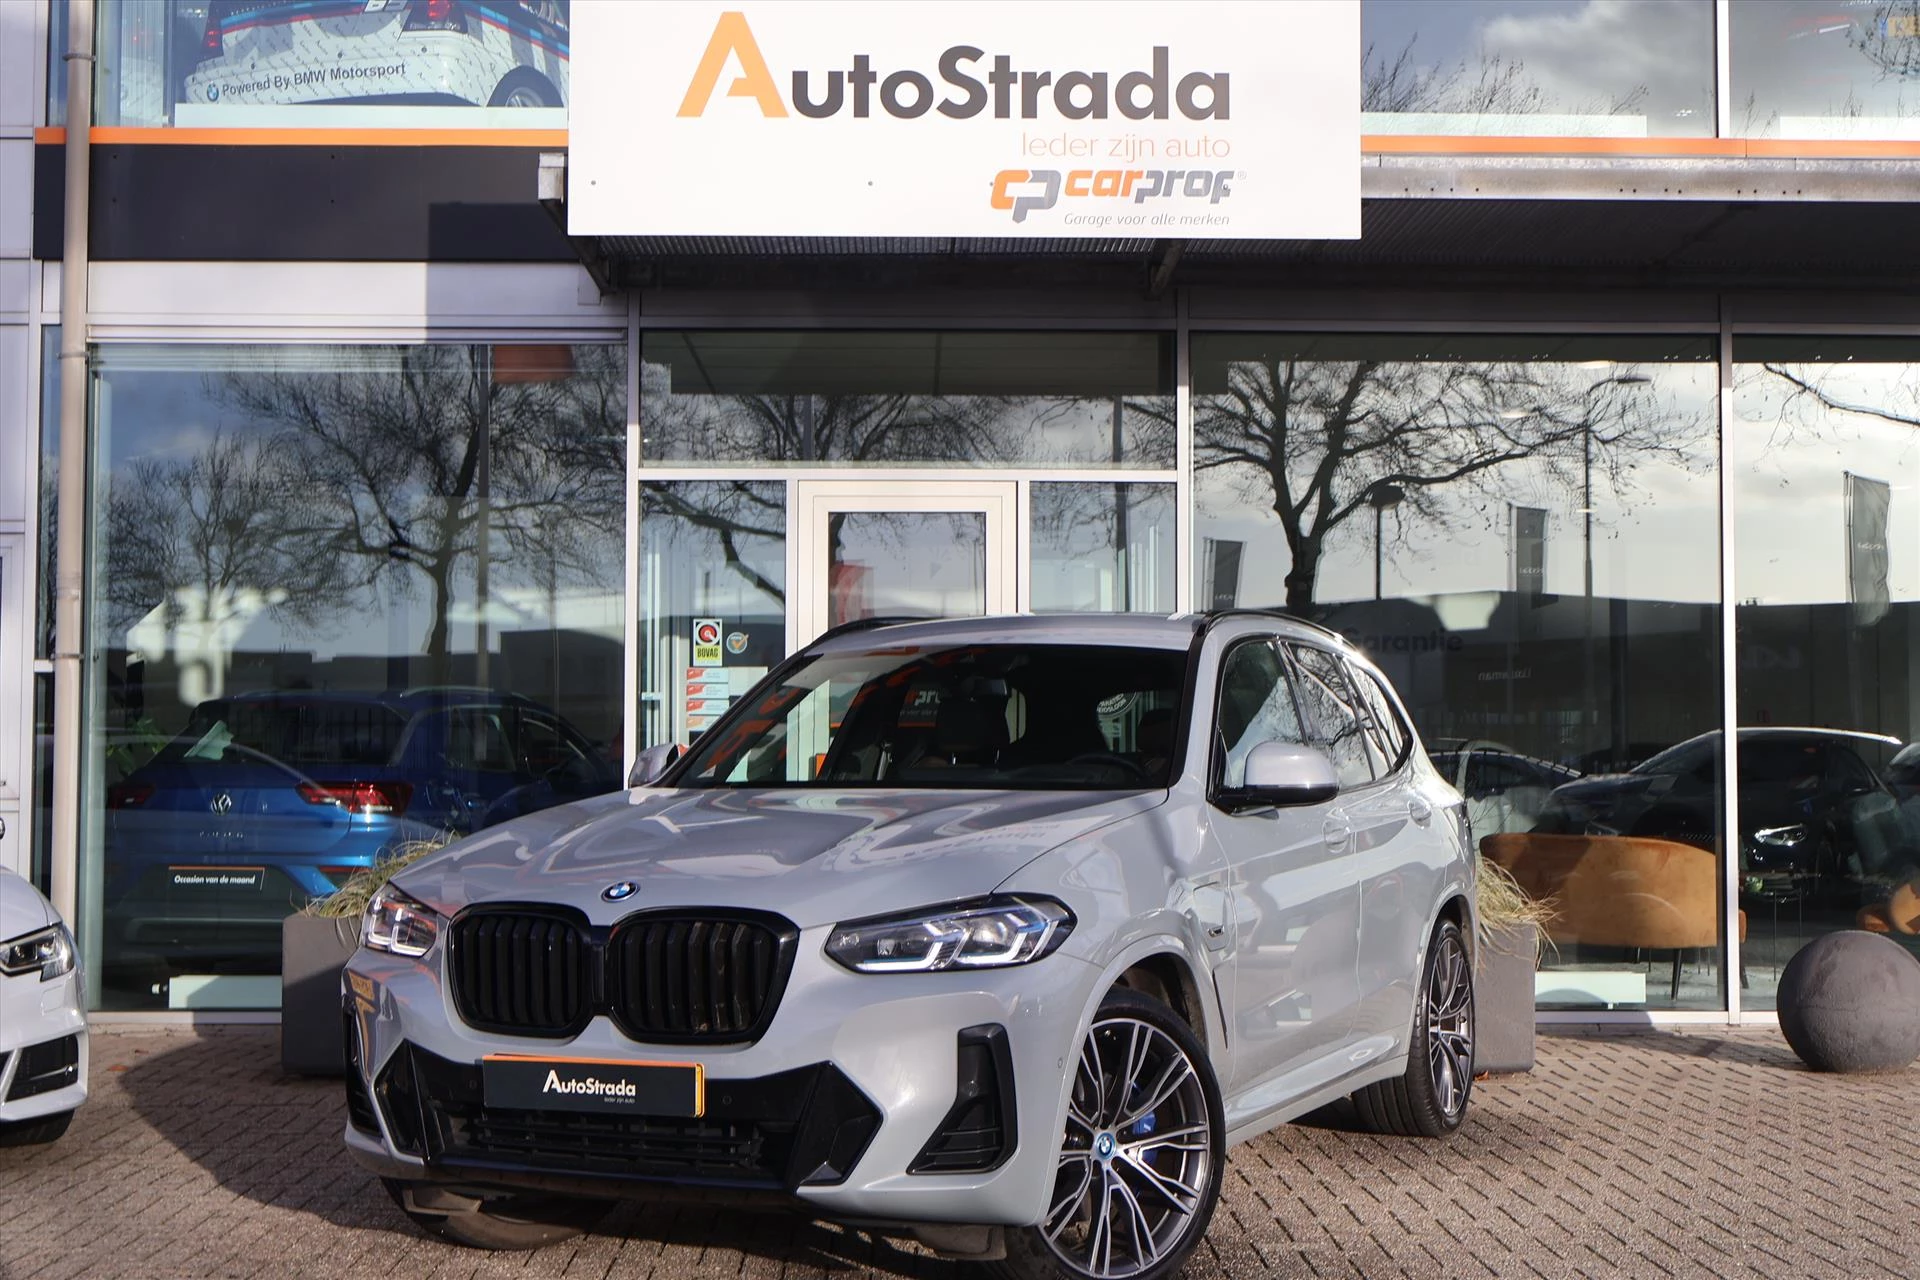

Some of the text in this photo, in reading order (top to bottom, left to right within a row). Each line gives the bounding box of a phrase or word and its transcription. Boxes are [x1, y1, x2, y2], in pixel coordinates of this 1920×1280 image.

[222, 63, 406, 97] Powered By BMW Motorsport
[676, 11, 1230, 121] AutoStrada
[1022, 132, 1231, 163] Ieder zijn auto
[1064, 212, 1230, 228] Garage voor alle merken
[697, 647, 719, 658] BOVAG
[174, 874, 256, 885] Occasion van de maand
[542, 1069, 636, 1097] AutoStrada
